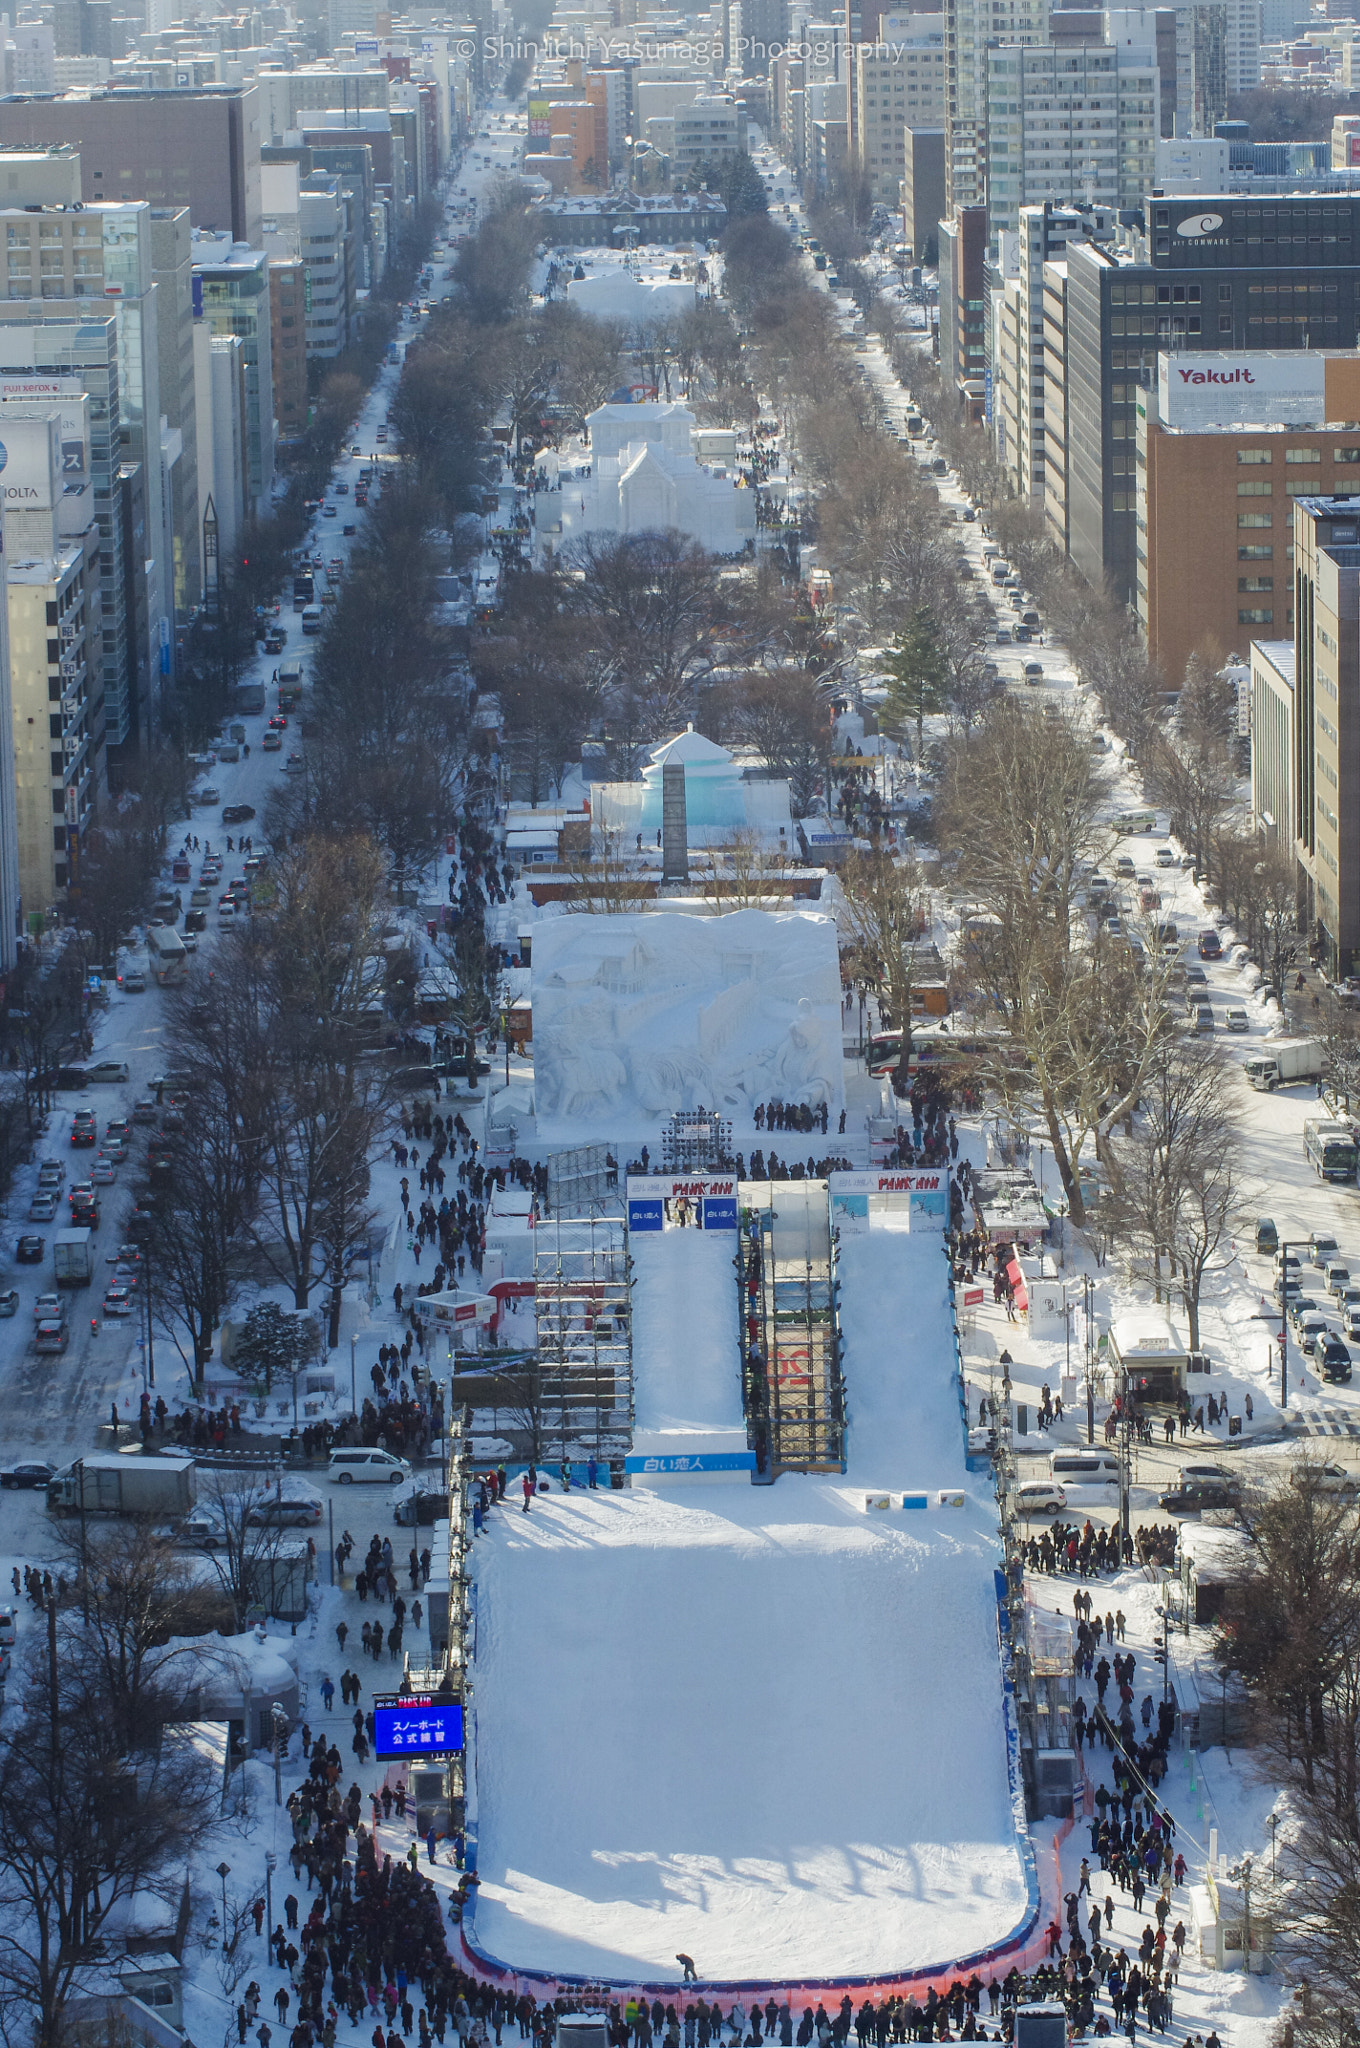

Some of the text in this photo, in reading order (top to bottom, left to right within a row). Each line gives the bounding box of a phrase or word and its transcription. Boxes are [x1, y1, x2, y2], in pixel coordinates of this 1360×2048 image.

[177, 74, 187, 85] P
[1187, 238, 1230, 246] COMWARE
[1178, 368, 1256, 385] Yakult
[3, 385, 21, 393] FUJI
[631, 1212, 660, 1220] 白い恋人
[707, 1210, 735, 1218] 白い恋人
[643, 1456, 704, 1472] 白い恋人
[393, 1720, 444, 1732] スノーボード
[393, 1731, 445, 1745] 公式練習
